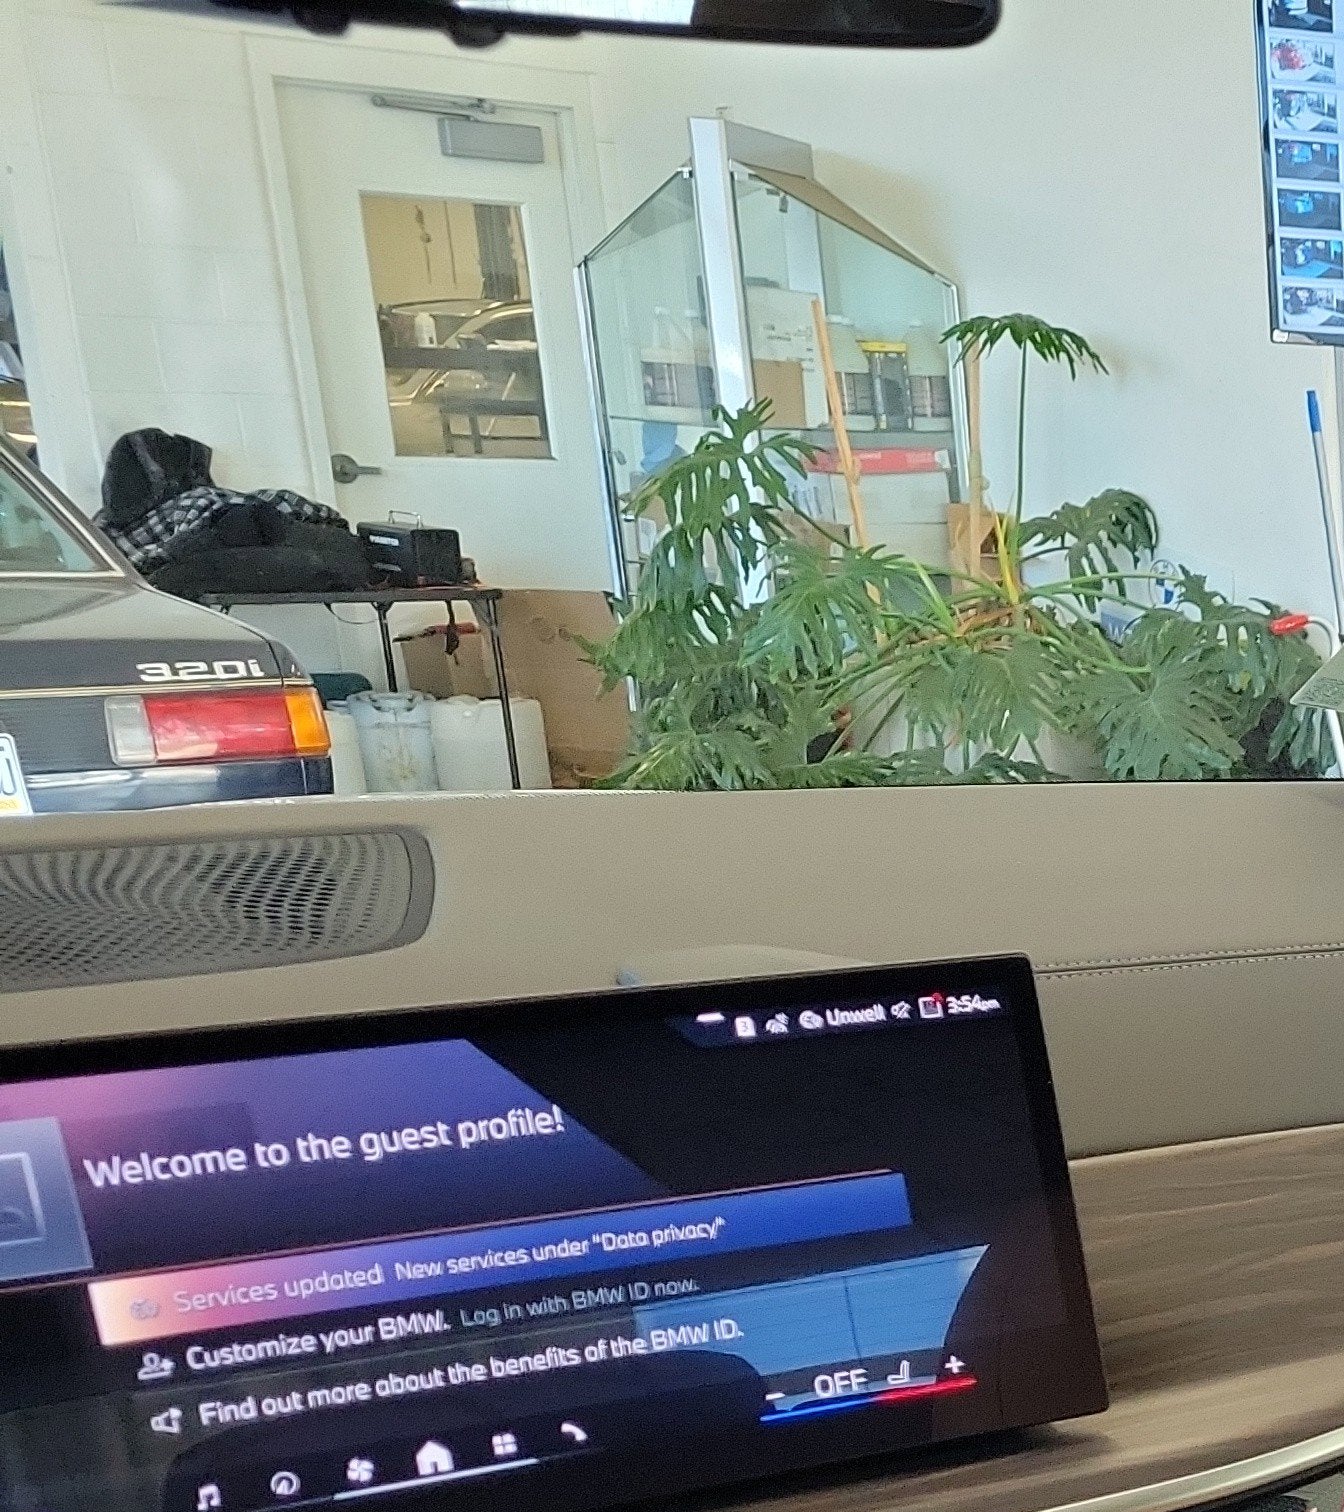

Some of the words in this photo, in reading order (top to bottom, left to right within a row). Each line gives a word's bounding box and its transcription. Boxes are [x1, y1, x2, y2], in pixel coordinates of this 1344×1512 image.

[135, 659, 265, 682] 320i
[83, 1148, 246, 1189] Welcome
[255, 1140, 290, 1168] to
[295, 1132, 352, 1162] the
[362, 1119, 452, 1163] guest
[457, 1104, 565, 1150] profile!
[173, 1281, 278, 1315] Services
[283, 1262, 385, 1301] updated
[394, 1258, 443, 1284] New
[446, 1247, 529, 1275] services
[531, 1238, 590, 1263] under
[186, 1333, 318, 1372] Customize
[318, 1324, 375, 1355] your
[378, 1310, 451, 1342] BMW.
[460, 1302, 502, 1331] Log
[503, 1300, 522, 1321] in
[523, 1293, 567, 1318] with
[571, 1284, 626, 1312] BMW
[627, 1278, 650, 1303] ID
[653, 1276, 700, 1302] now.
[198, 1397, 258, 1428] Find
[263, 1391, 304, 1417] out
[306, 1381, 372, 1410] more
[375, 1368, 445, 1400] about
[447, 1360, 487, 1387] the
[490, 1345, 581, 1379] benefits
[584, 1339, 610, 1365] of
[609, 1333, 648, 1360] the
[648, 1322, 711, 1354] BMW
[713, 1316, 744, 1343] ID.
[814, 1368, 869, 1398] OFF
